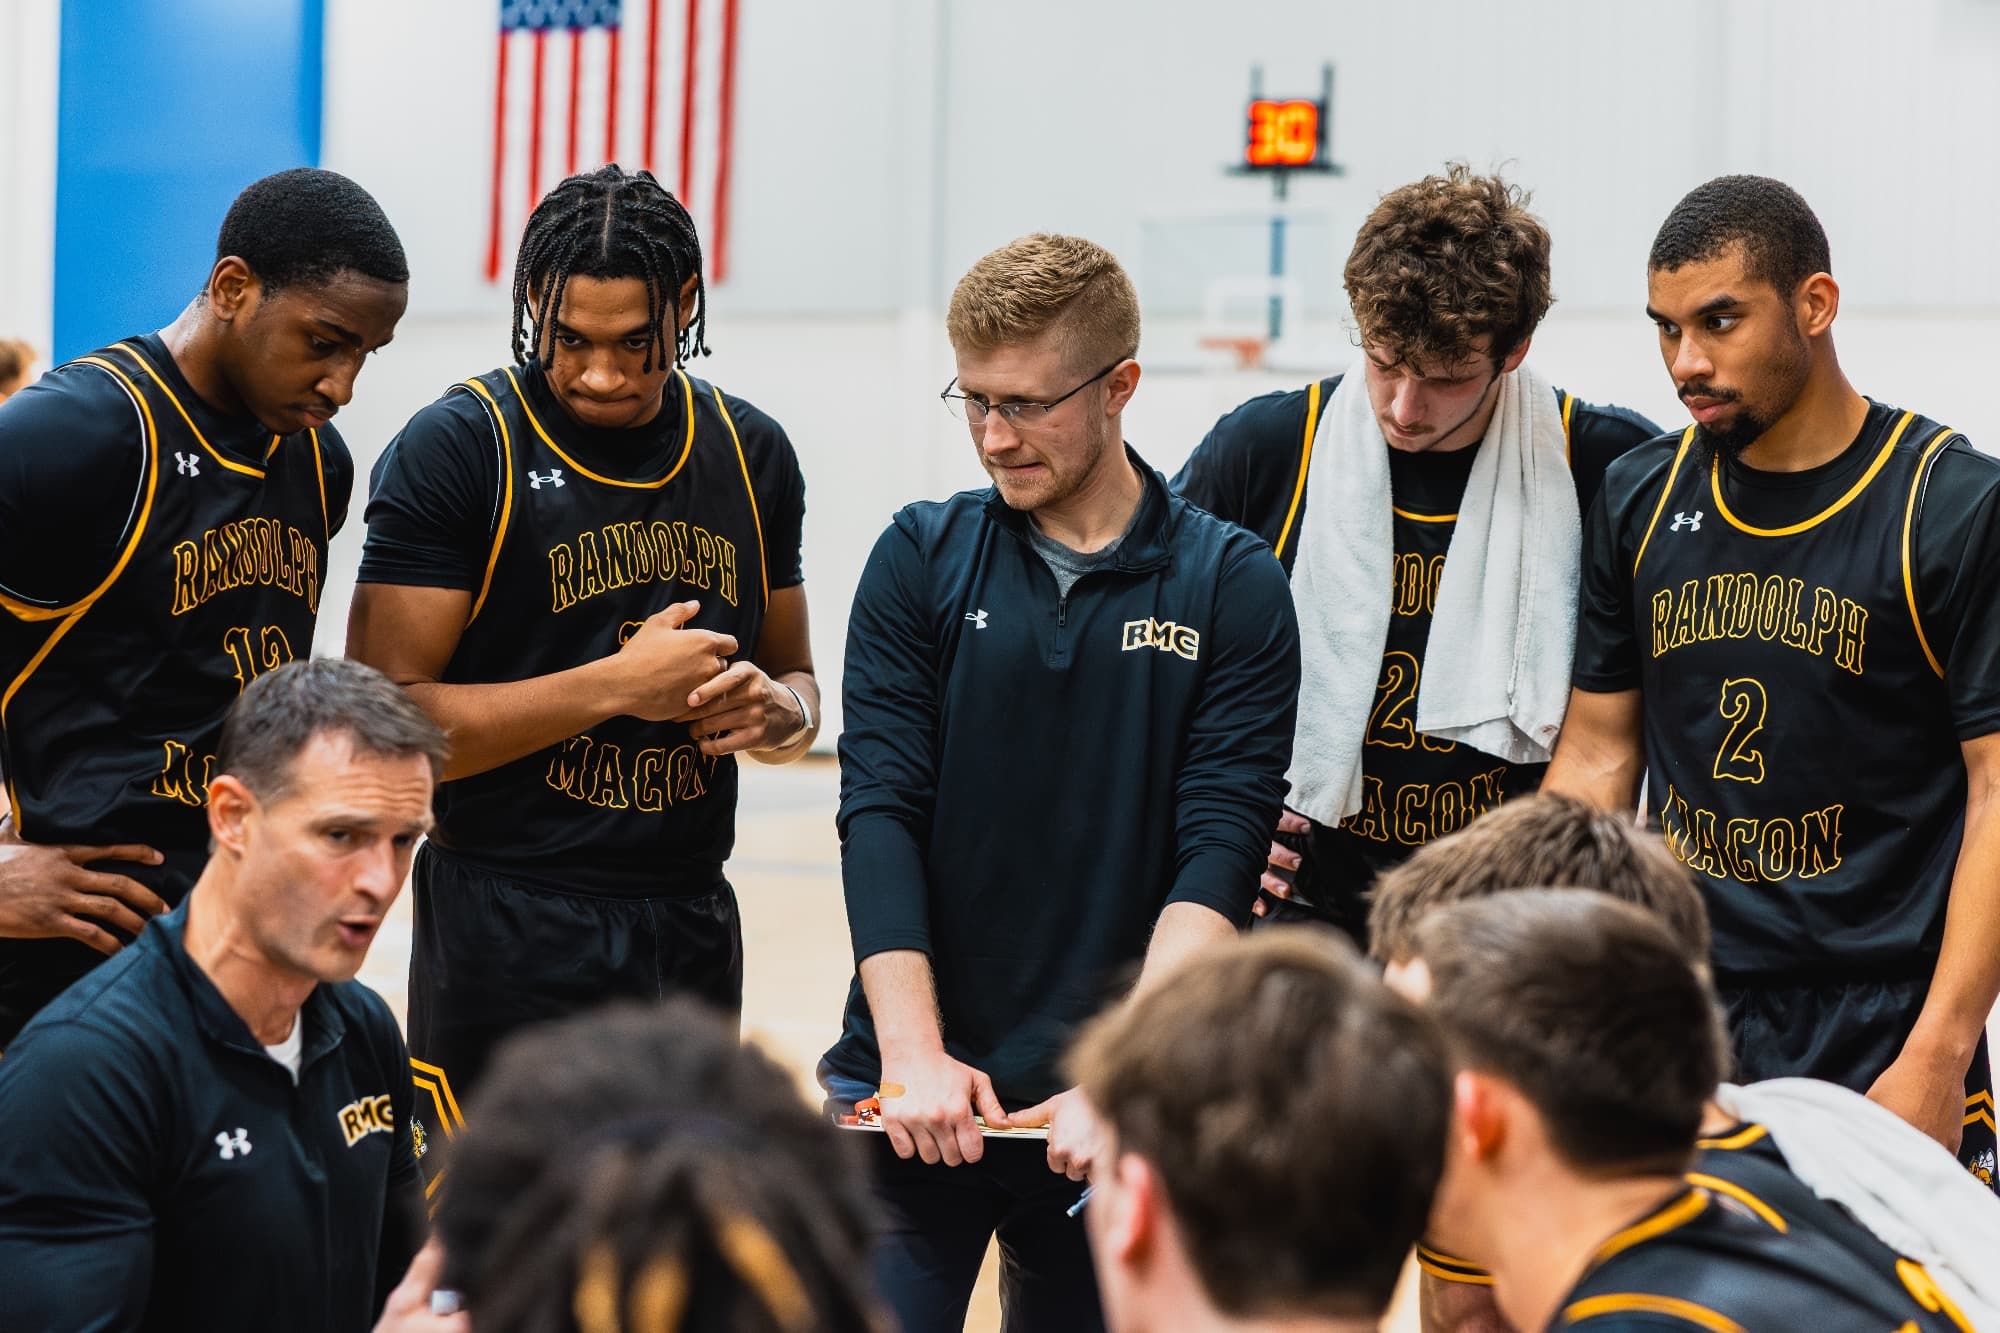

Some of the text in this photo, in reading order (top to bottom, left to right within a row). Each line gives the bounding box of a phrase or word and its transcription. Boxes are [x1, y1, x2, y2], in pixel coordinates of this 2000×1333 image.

[1246, 99, 1317, 165] 30
[172, 517, 318, 616] RANDOLPH
[549, 521, 738, 613] RANDOLPH
[1121, 616, 1200, 661] RMC
[1652, 572, 1868, 675] RANDOLPH
[1365, 651, 1457, 752] 2
[1713, 677, 1767, 784] 2
[1340, 766, 1507, 845] ACON
[1661, 784, 1845, 882] MACON
[337, 1094, 395, 1147] RMC
